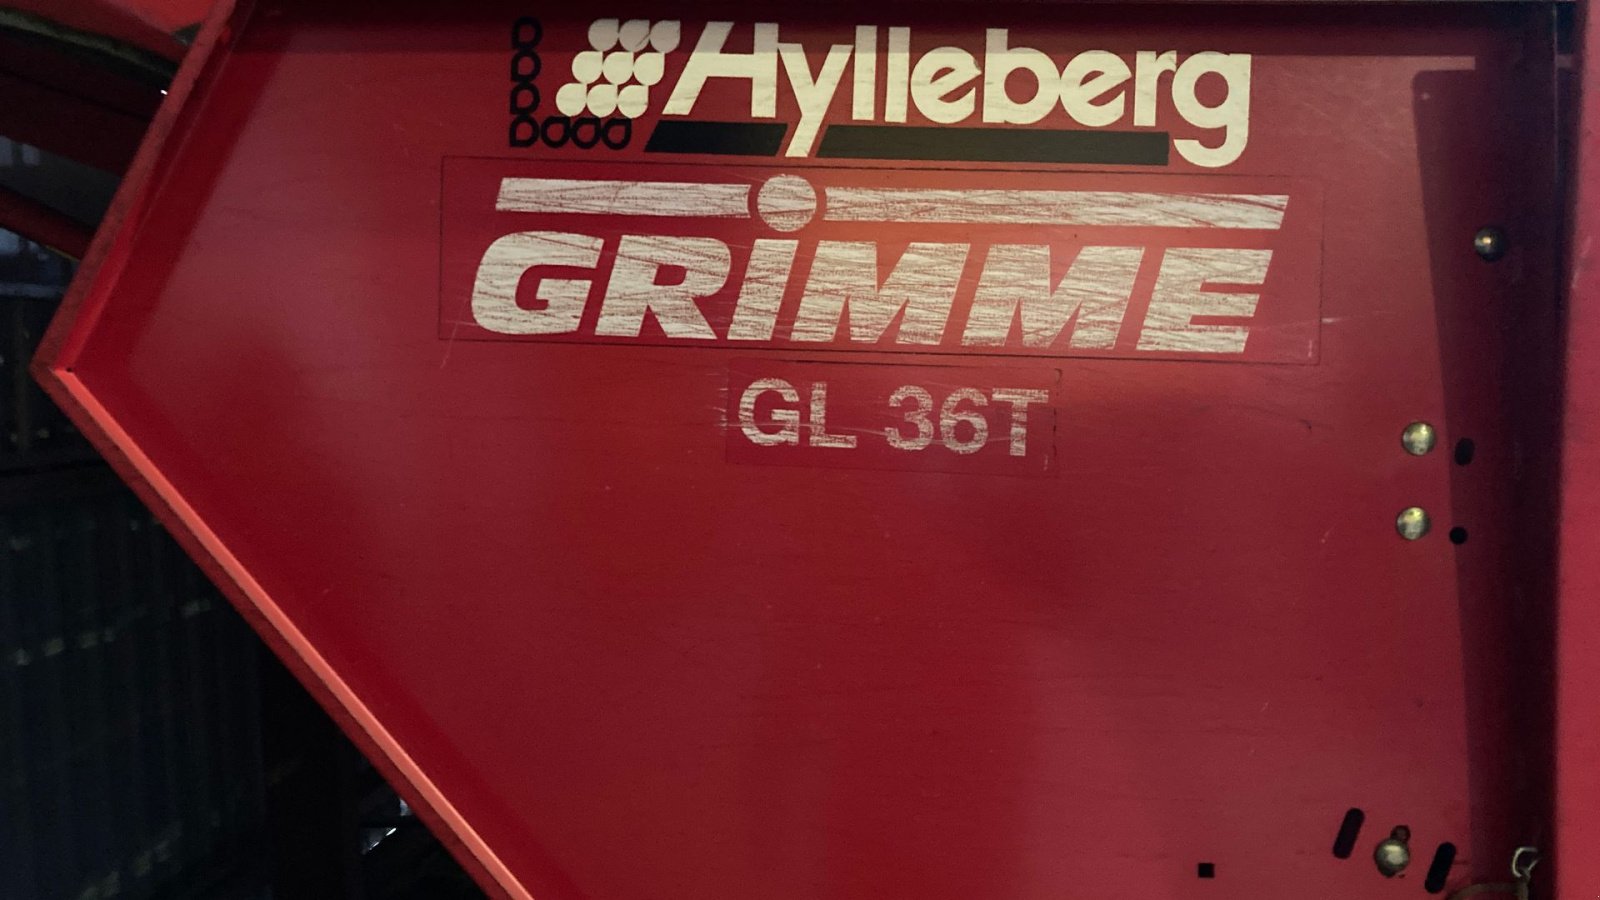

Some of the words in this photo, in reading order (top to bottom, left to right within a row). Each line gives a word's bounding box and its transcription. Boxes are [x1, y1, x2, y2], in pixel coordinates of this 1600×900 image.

[662, 22, 1252, 168] Hylleberg
[471, 174, 1274, 354] GRIMME
[738, 378, 857, 450] GL
[885, 385, 1049, 457] 36T
